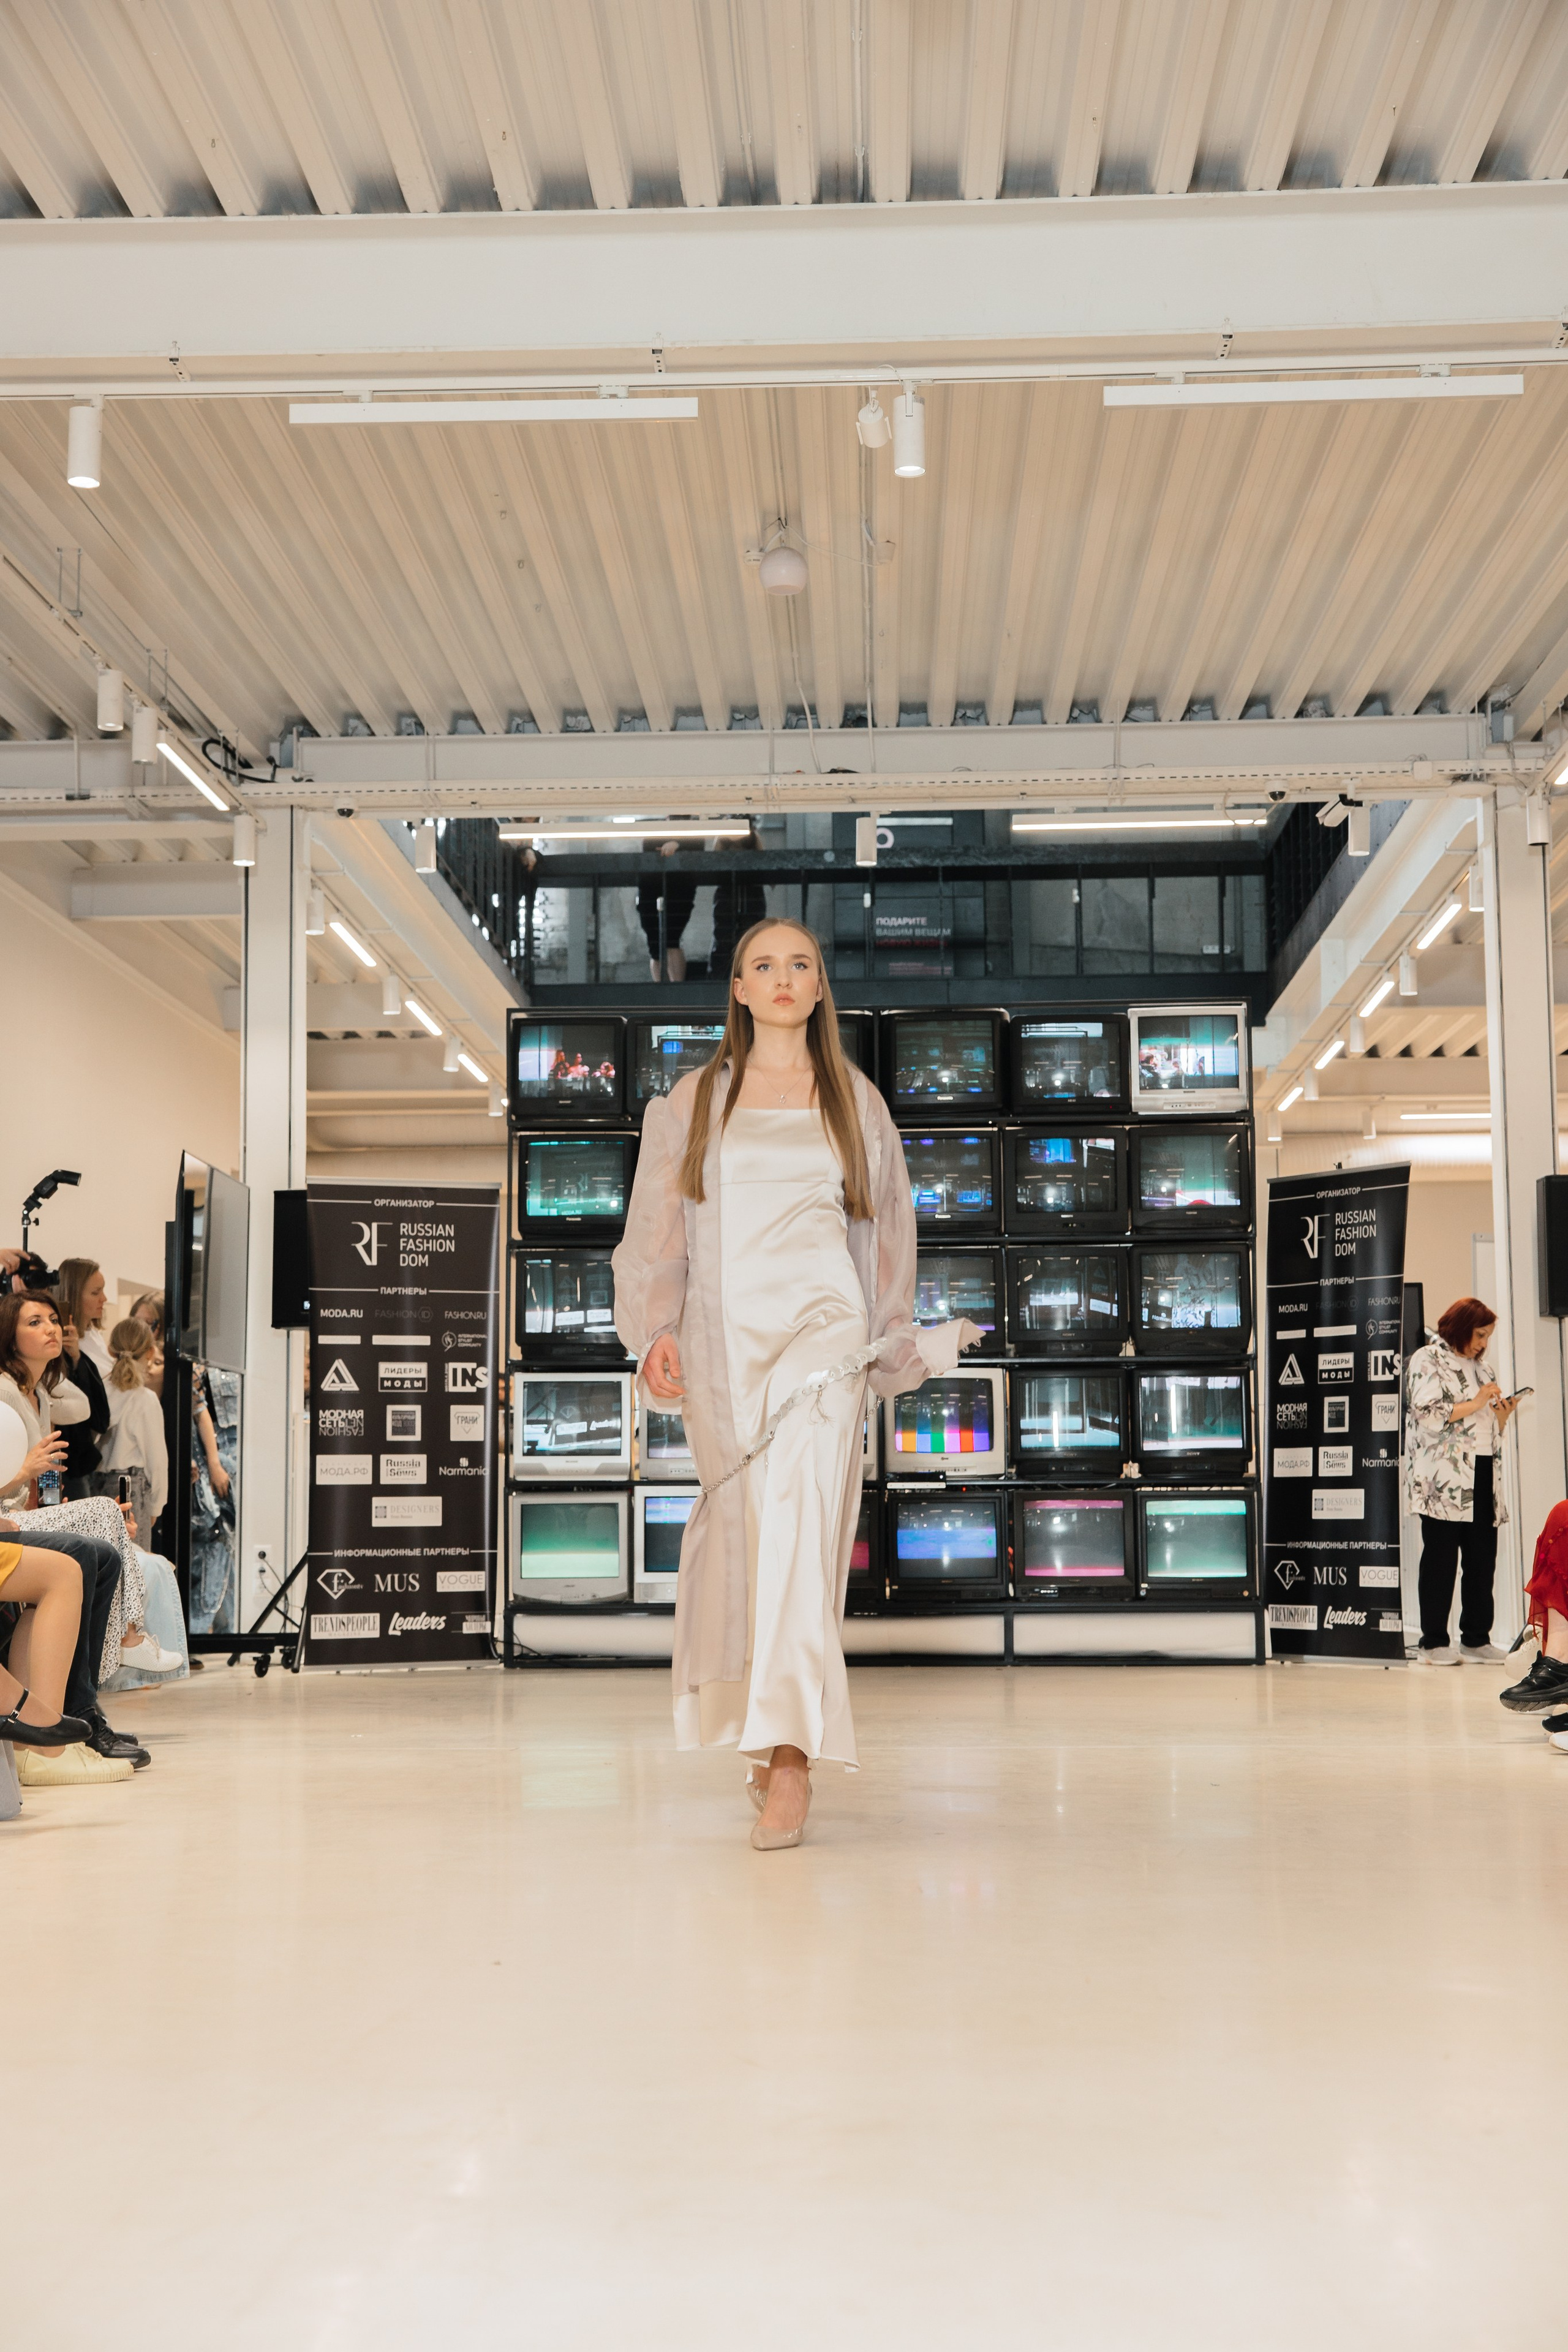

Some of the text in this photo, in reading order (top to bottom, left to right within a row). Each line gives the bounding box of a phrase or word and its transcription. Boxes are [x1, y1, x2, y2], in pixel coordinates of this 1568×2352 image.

[876, 918, 927, 926] ПОДАРИТЕ
[1317, 1187, 1360, 1199] ОРГАНИЗАТОР
[374, 1199, 434, 1208] ОРГАНИЗАТОР
[1335, 1209, 1376, 1225] RUSSIAN
[400, 1223, 454, 1237] RUSSIAN
[1335, 1225, 1376, 1240] FASHION
[400, 1238, 454, 1252] FASHION
[1335, 1242, 1355, 1257] DOM
[400, 1254, 428, 1267] DOM
[1320, 1276, 1354, 1286] ПАРТНЕРЫ
[380, 1287, 427, 1295] ПАРТНЕРЫ
[320, 1309, 363, 1317] MODA.RU
[1278, 1303, 1308, 1313] MODA.RU
[1277, 1403, 1307, 1413] МОДНАЯ
[1378, 1405, 1395, 1414] ГРАНИ
[319, 1409, 364, 1419] МОДНАЯ
[1276, 1412, 1295, 1421] СЕТЬ
[318, 1419, 345, 1428] СЕТЬ
[456, 1415, 478, 1425] ГРАНИ
[1323, 1450, 1349, 1459] Russia
[1277, 1460, 1310, 1469] МОДА.РФ
[320, 1468, 368, 1476] МОДА.РФ
[1326, 1498, 1362, 1506] DESIGNERS
[390, 1505, 440, 1513] DESIGNERS
[1287, 1541, 1387, 1550] ИНФОРМАЦИОННЫЕ ПАРТНЕРЫ
[334, 1547, 469, 1558] ИНФОРМАЦИОННЫЕ ПАРТНЕРЫ
[439, 1574, 483, 1585] VOGUE
[1313, 1566, 1347, 1586] MUS
[1360, 1570, 1398, 1580] VOGUE
[374, 1573, 420, 1593] MUS
[1323, 1605, 1367, 1630] Leaders
[388, 1611, 447, 1635] Leaders
